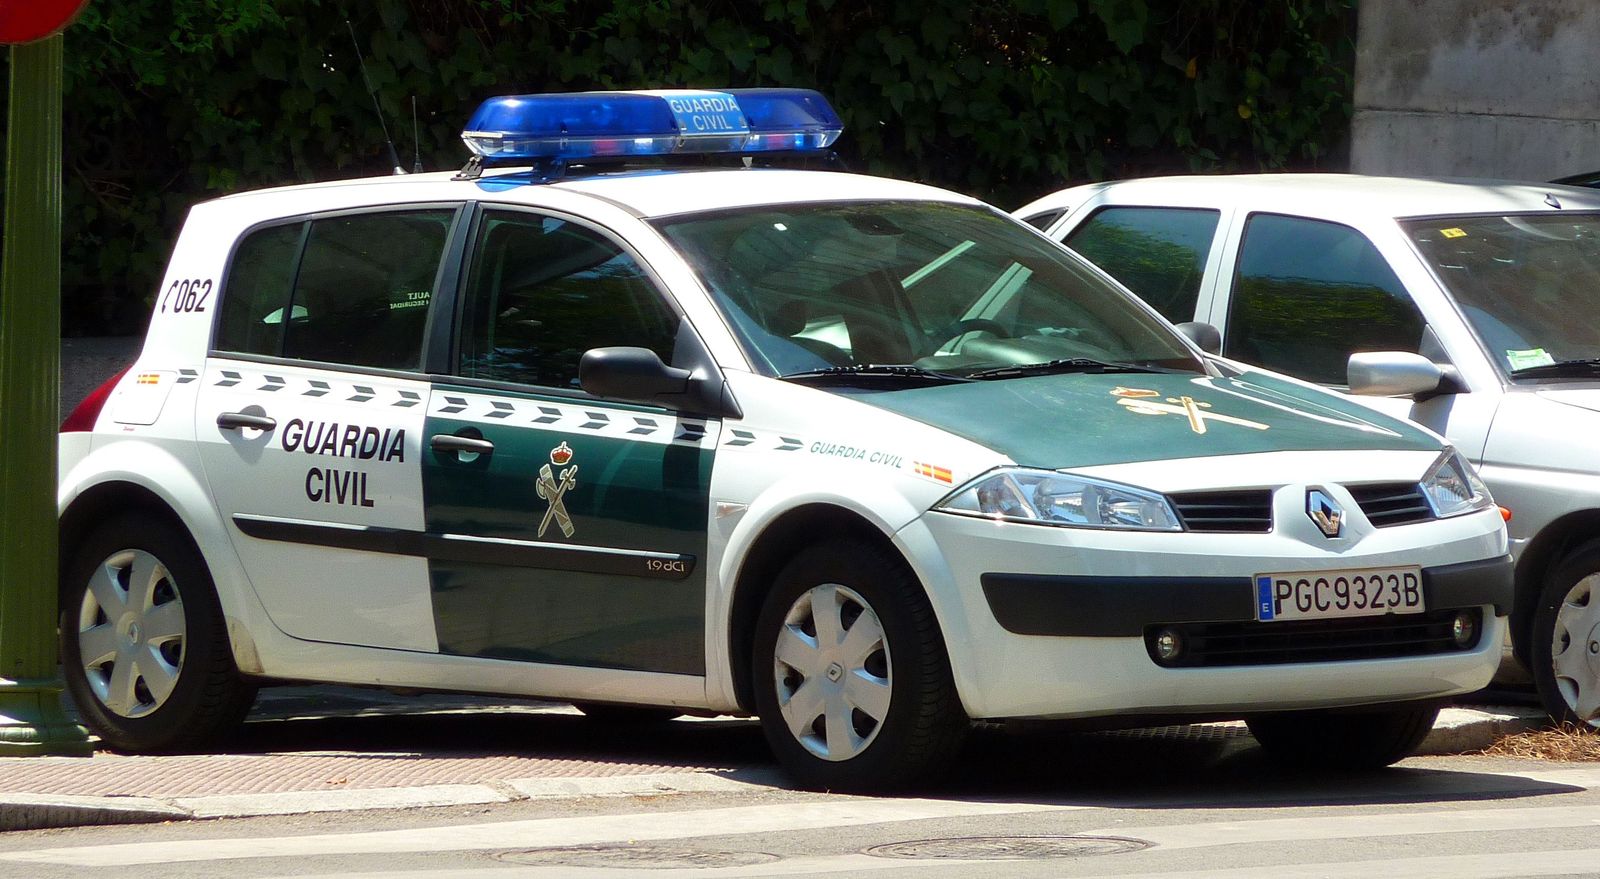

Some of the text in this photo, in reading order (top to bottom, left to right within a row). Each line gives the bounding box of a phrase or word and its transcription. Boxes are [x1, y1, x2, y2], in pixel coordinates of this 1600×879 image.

[670, 98, 741, 113] GUARDIA
[693, 115, 733, 131] CIVIL
[174, 278, 213, 313] 062
[281, 418, 406, 463] GUARDIA
[810, 441, 904, 469] GUARDIA CIVIL
[305, 467, 375, 508] CIVIL
[663, 560, 685, 572] dCi
[1262, 572, 1420, 616] E PGC9323B
